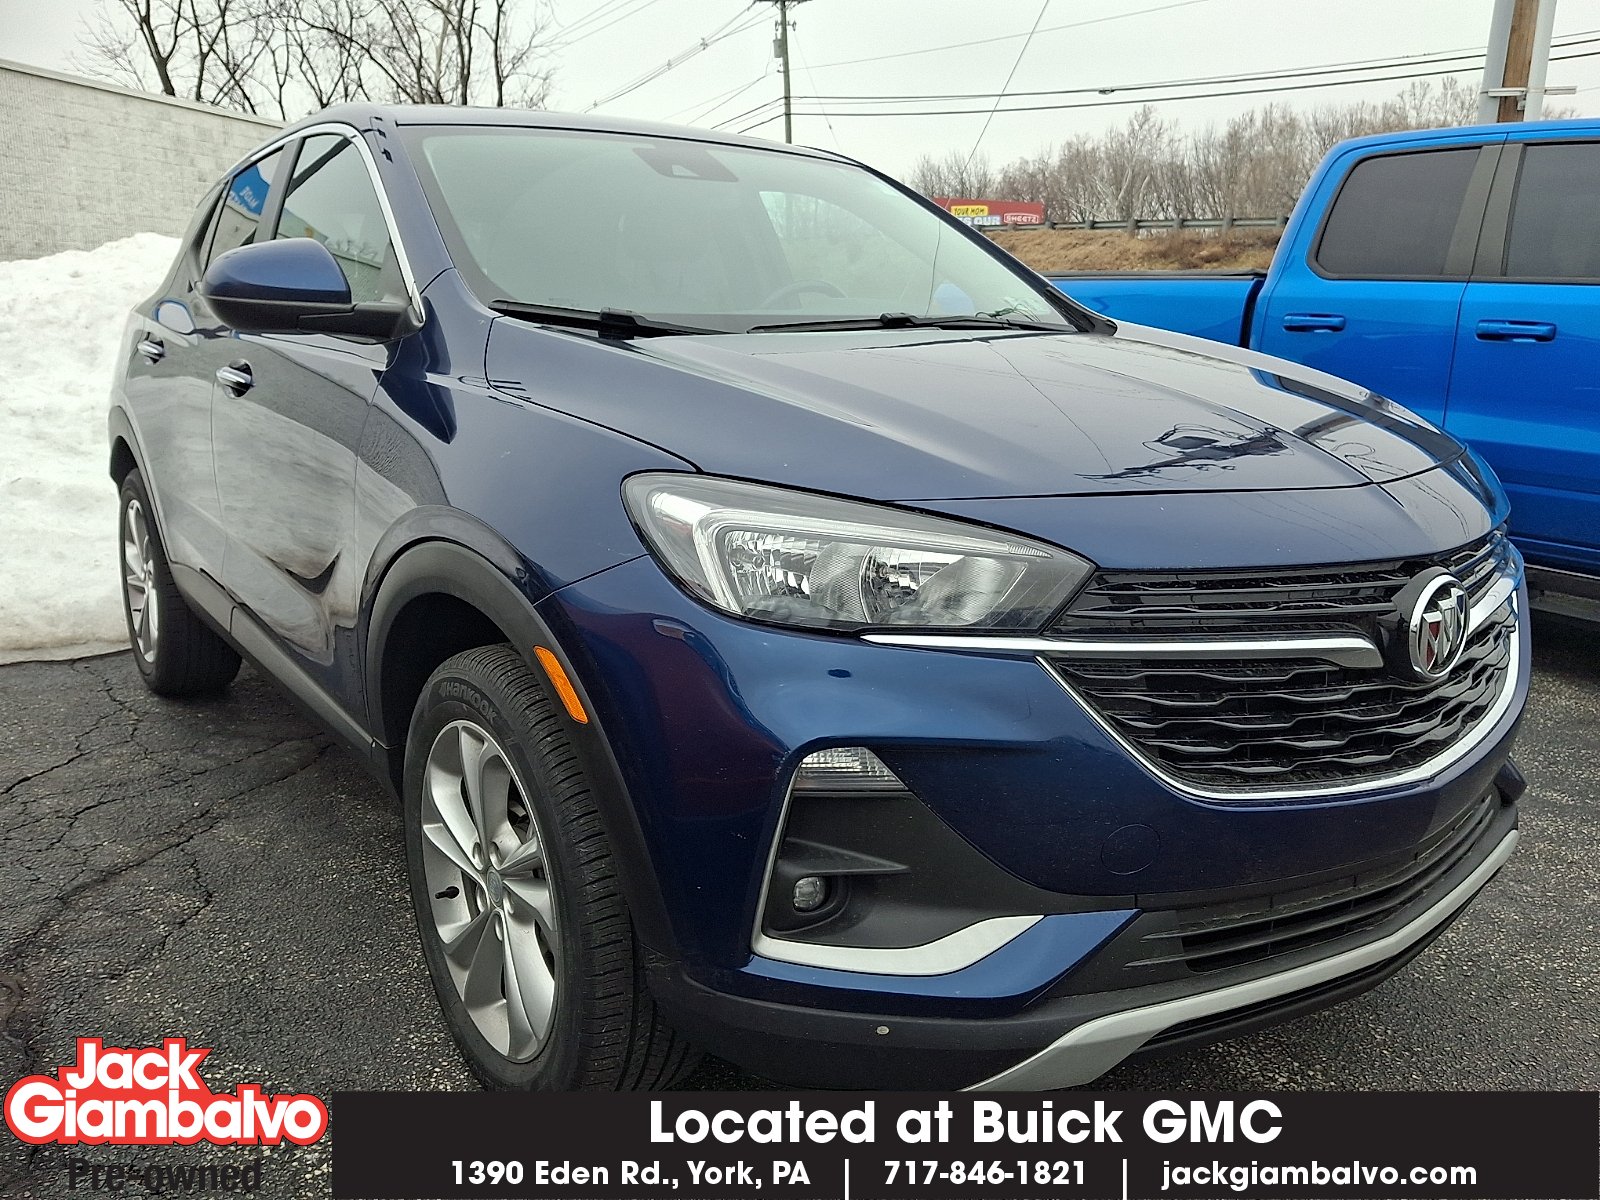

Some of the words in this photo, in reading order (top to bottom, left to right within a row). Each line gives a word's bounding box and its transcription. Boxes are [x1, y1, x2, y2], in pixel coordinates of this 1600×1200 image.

[954, 207, 969, 216] YOUR
[970, 207, 985, 215] MOM
[973, 215, 1001, 226] OUR
[1006, 215, 1037, 224] SHEETZ
